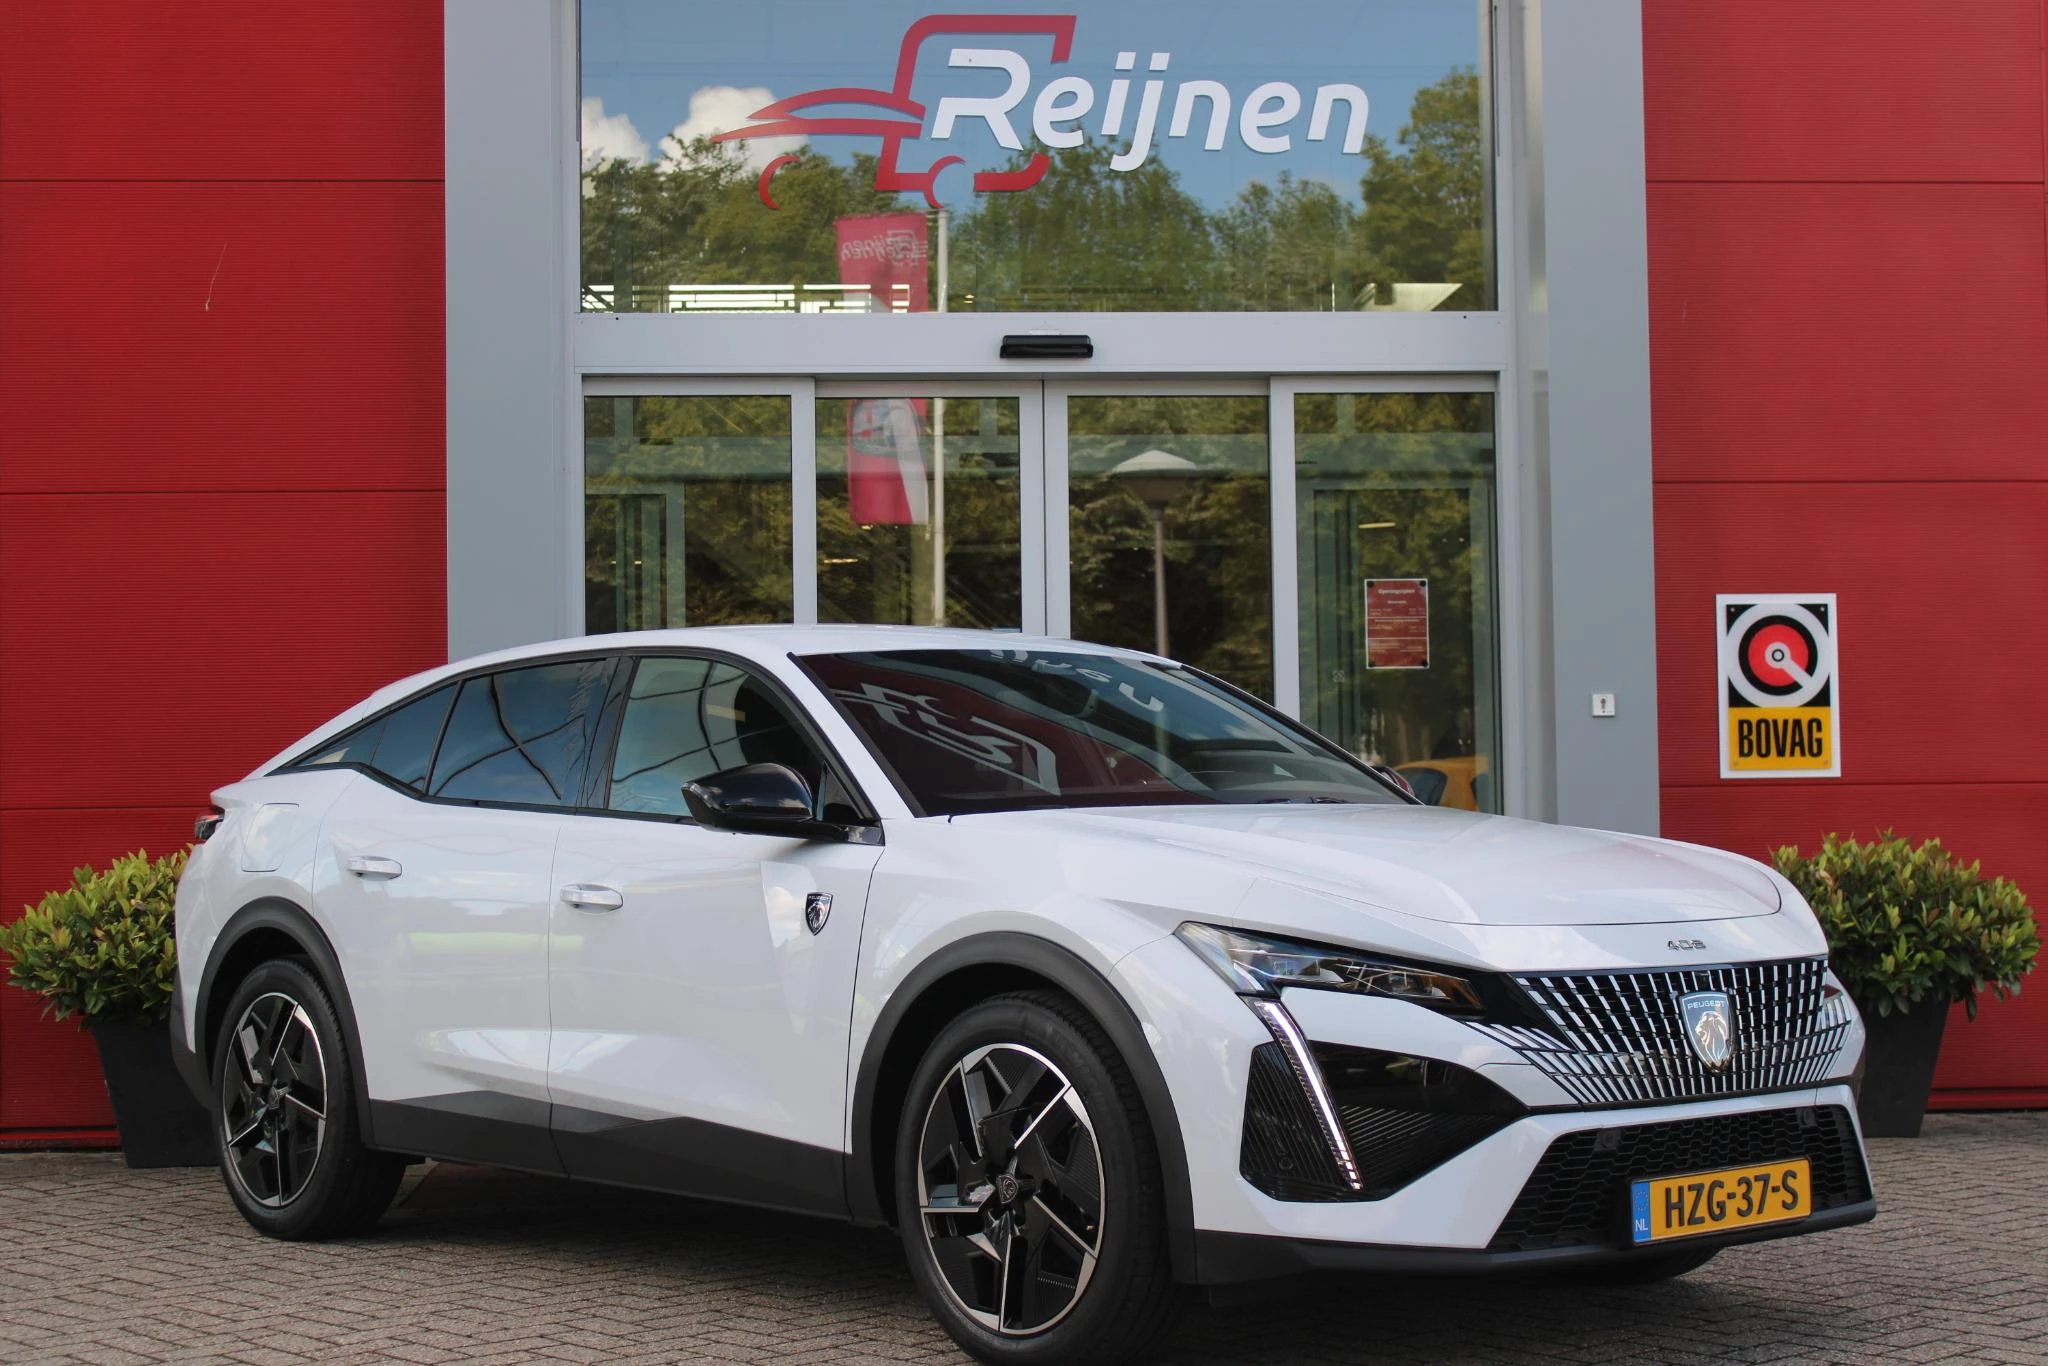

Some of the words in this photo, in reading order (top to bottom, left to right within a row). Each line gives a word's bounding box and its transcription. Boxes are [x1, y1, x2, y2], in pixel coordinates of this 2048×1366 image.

[931, 48, 1370, 172] Reijnen
[1738, 718, 1823, 758] BOVAG
[1668, 939, 1706, 950] 408
[1687, 1000, 1725, 1010] PEUGEOT
[1665, 1169, 1799, 1229] HZG-37-S
[1635, 1218, 1648, 1231] NL
